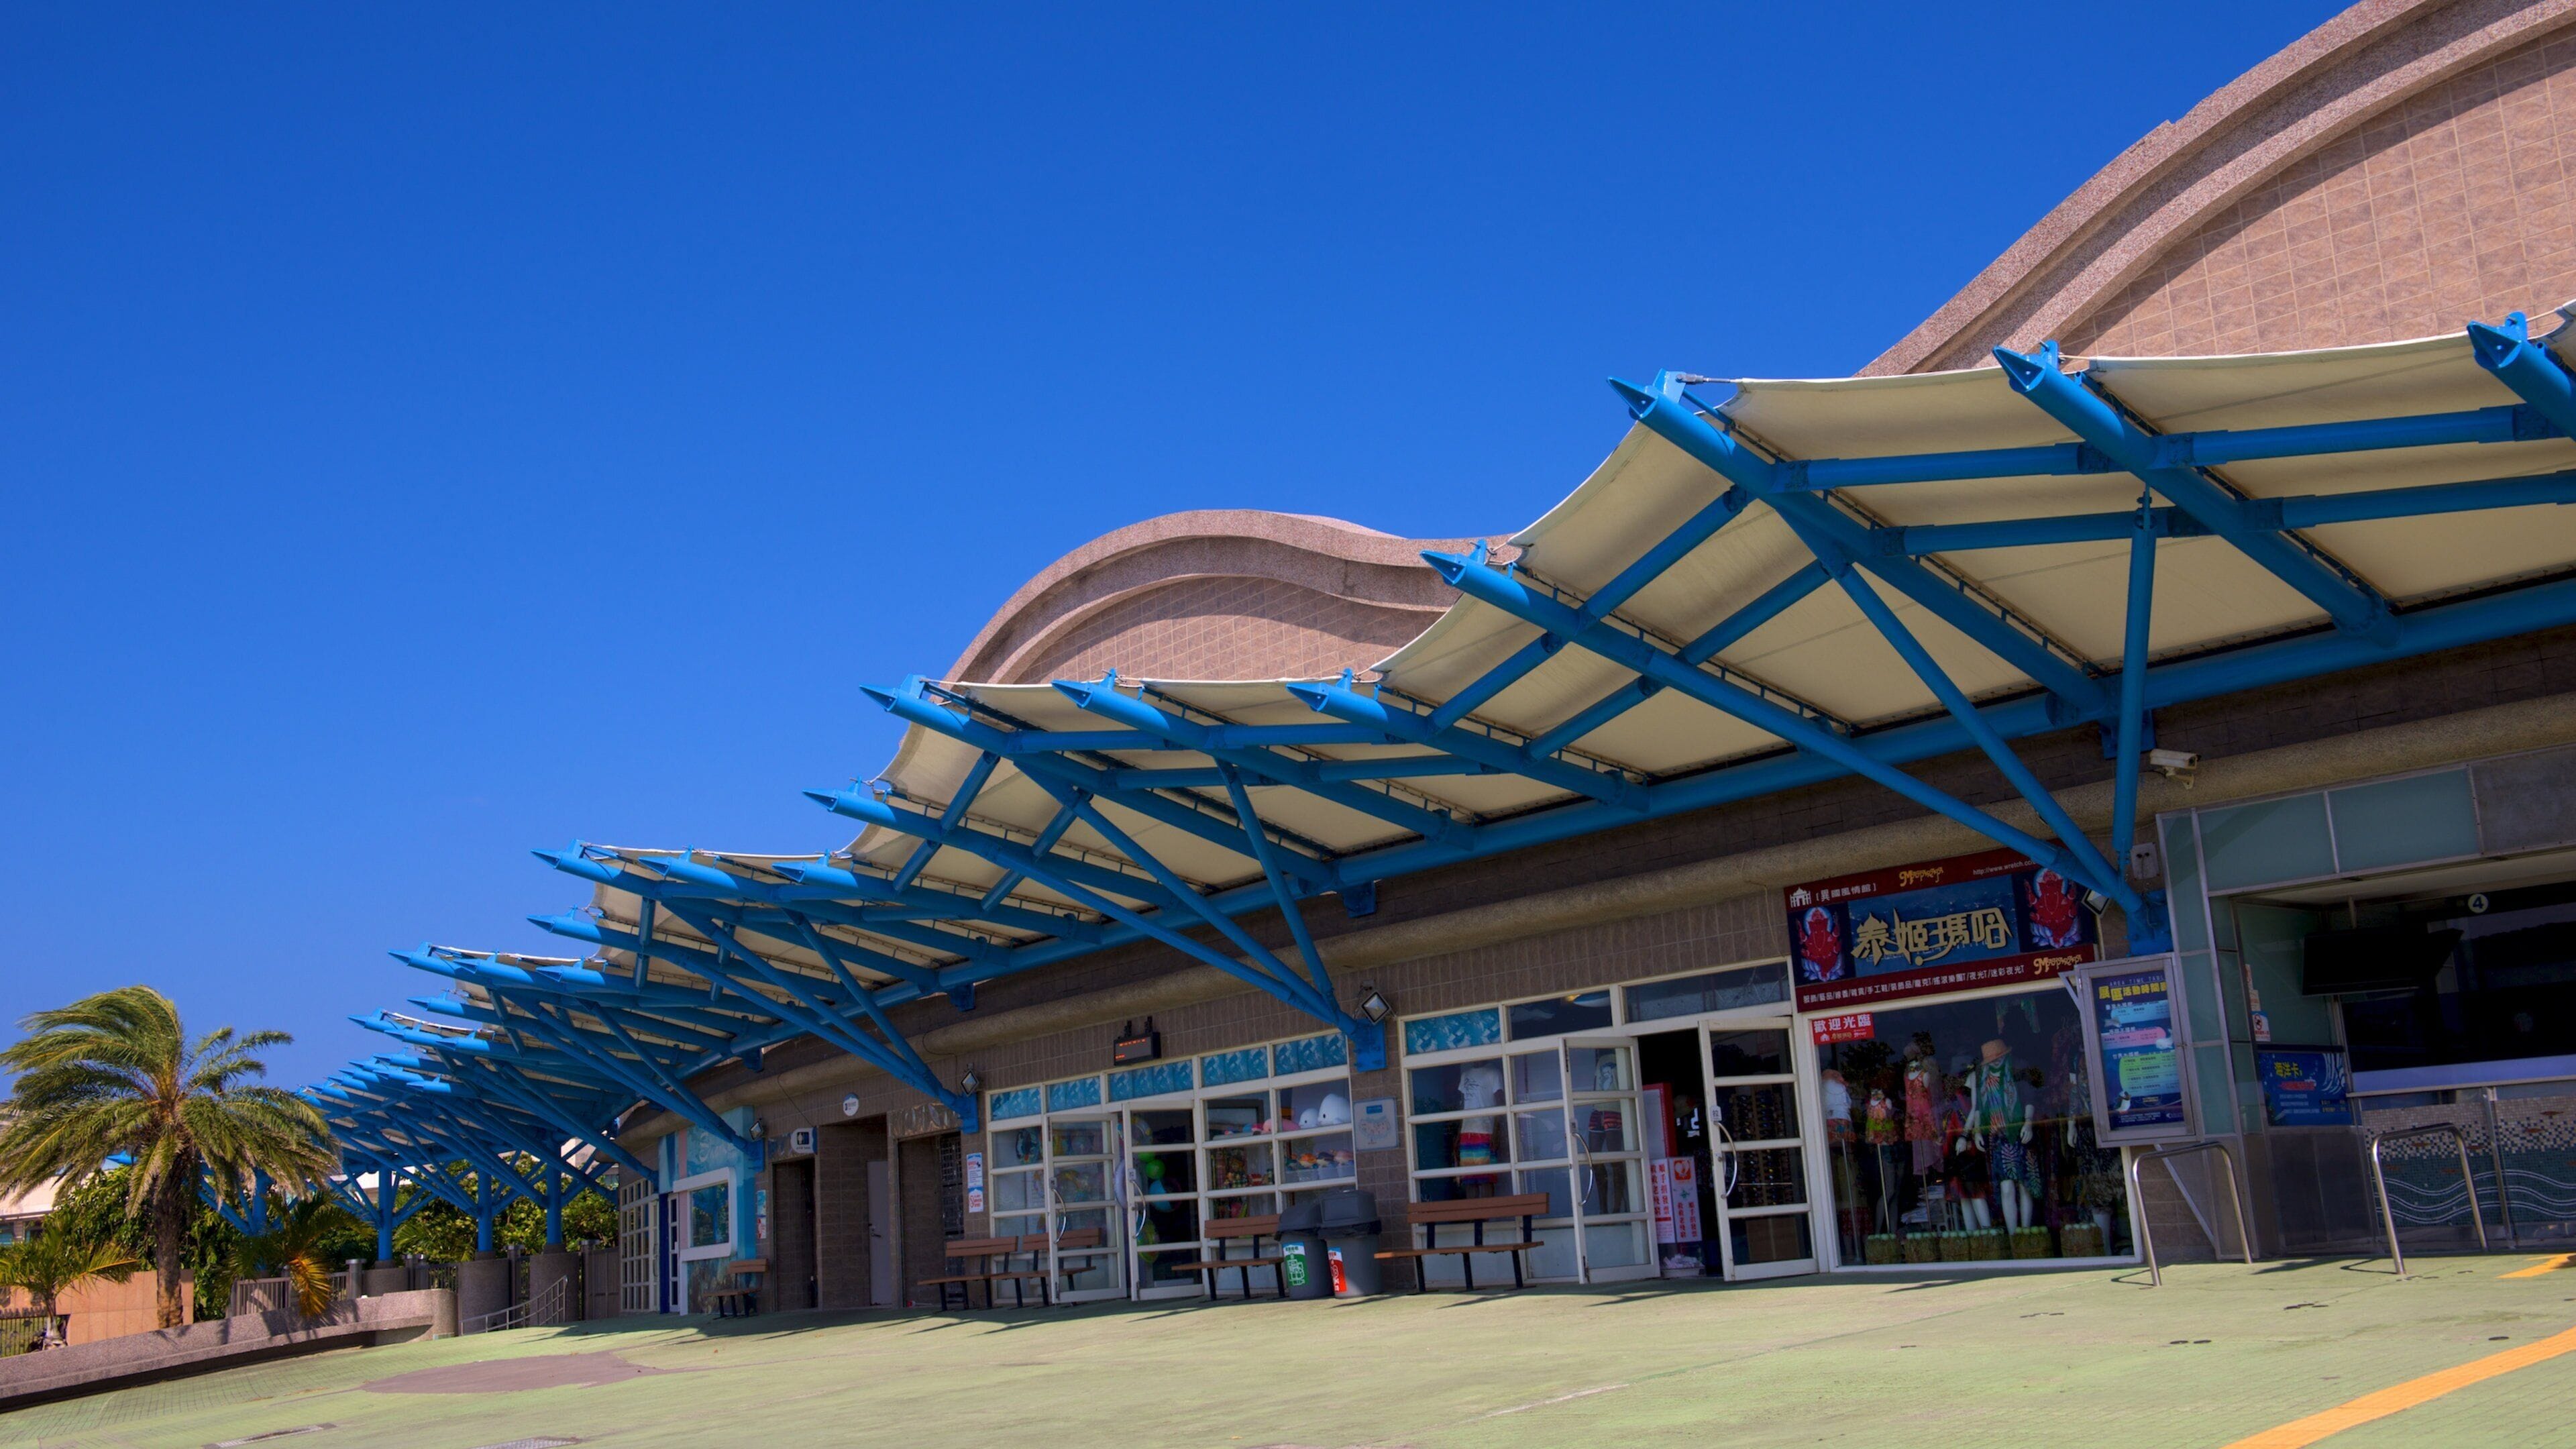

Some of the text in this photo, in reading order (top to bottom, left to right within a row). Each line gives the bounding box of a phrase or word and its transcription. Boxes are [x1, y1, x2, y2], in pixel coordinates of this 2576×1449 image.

[2473, 896, 2484, 909] 4
[1849, 907, 2013, 967] 泰姬瑪哈
[1813, 1014, 1871, 1033] 歡迎光臨
